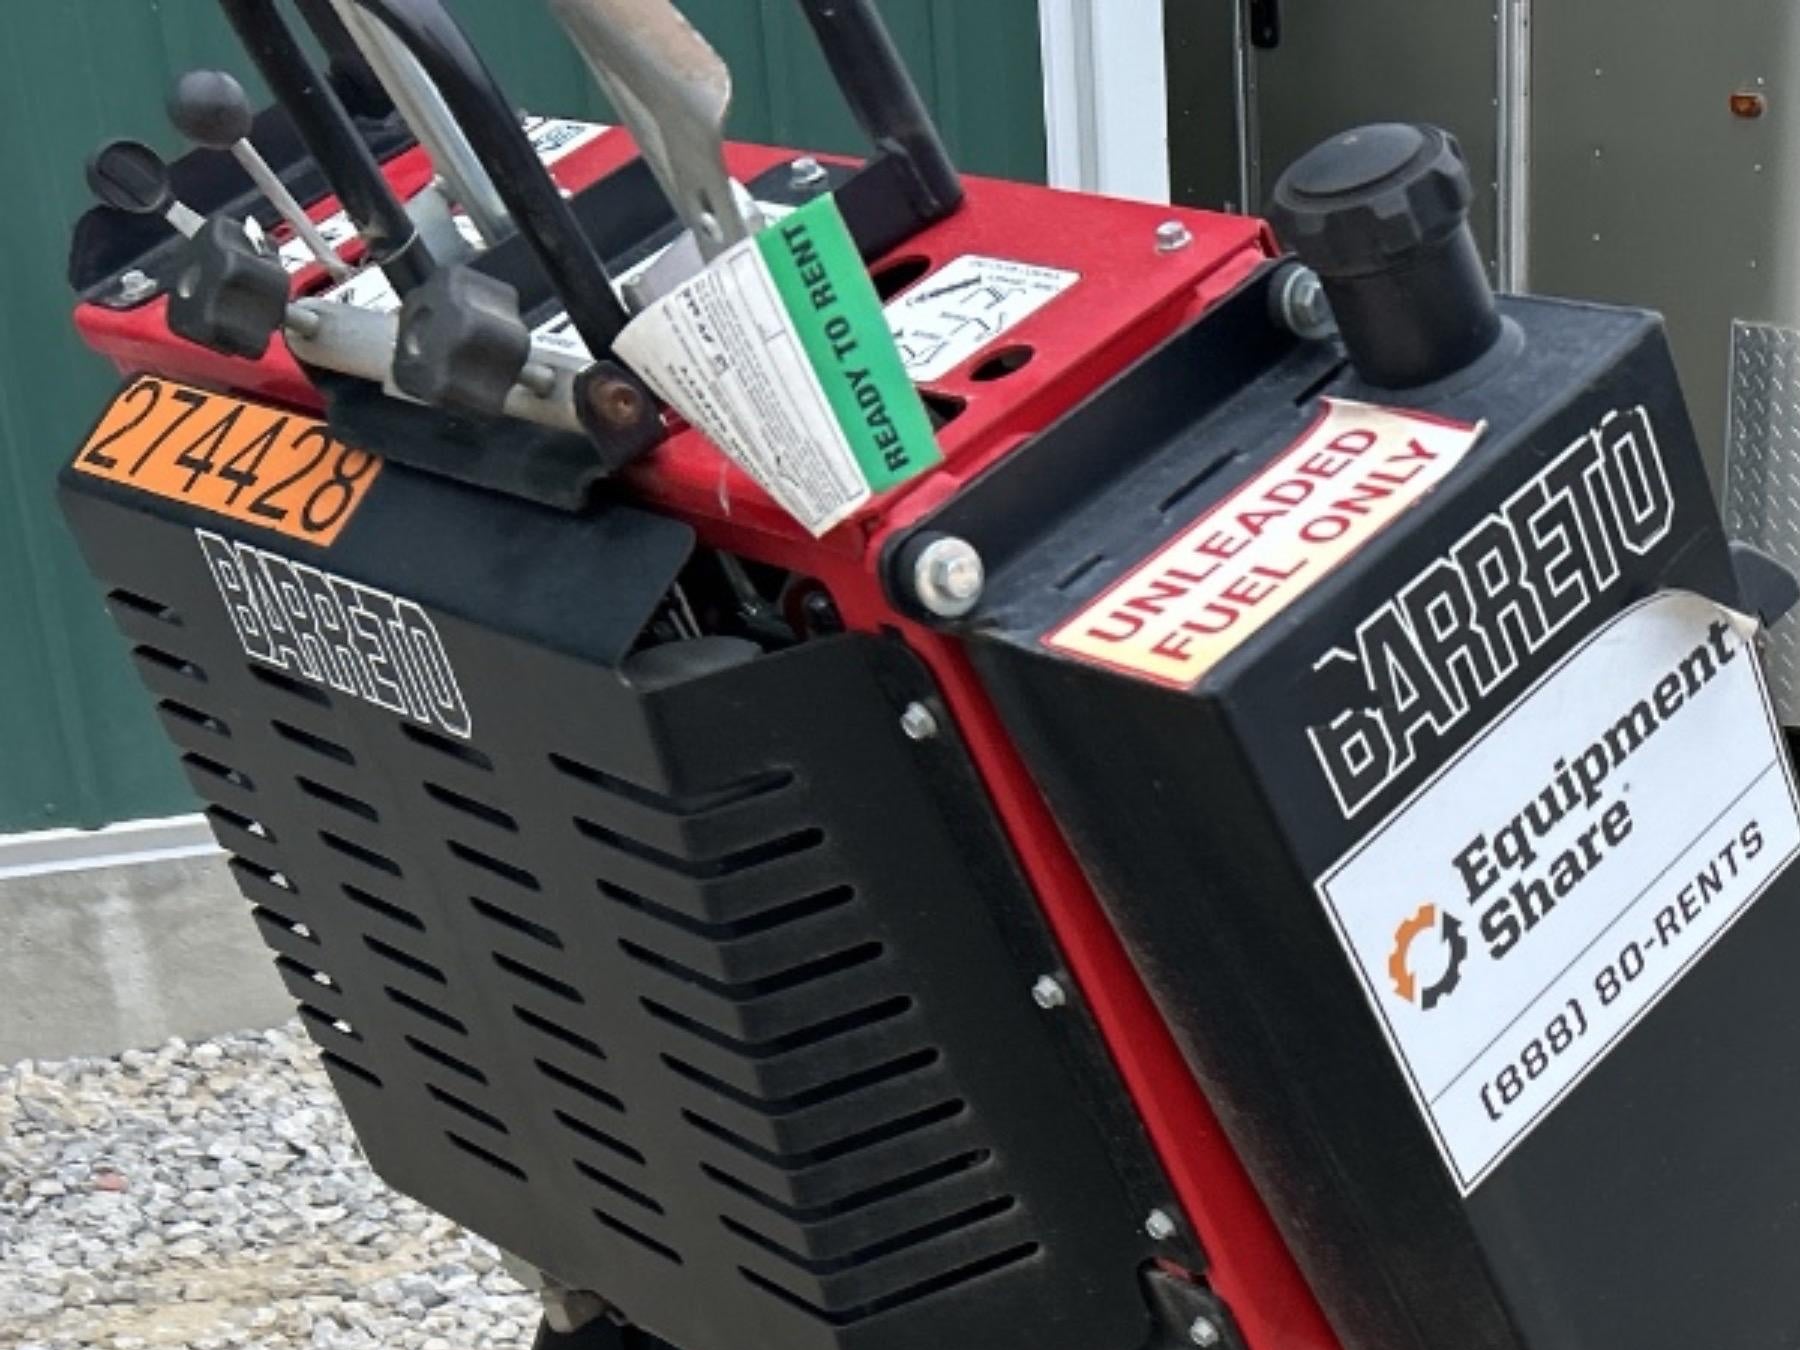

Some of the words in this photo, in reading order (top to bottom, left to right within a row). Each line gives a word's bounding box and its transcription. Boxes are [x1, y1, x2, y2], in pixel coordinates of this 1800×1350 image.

[780, 223, 839, 312] RENT
[823, 316, 861, 362] TO
[82, 379, 382, 533] 274428
[846, 367, 911, 473] READY
[194, 526, 472, 740] BARRETO
[1087, 427, 1379, 644] UNLEADED
[1150, 558, 1310, 663] FUEL
[1300, 437, 1440, 544] ONLY
[1306, 404, 1676, 820] BARRETO
[1451, 618, 1737, 905] Equipment
[1478, 798, 1634, 962] Share
[1478, 998, 1591, 1122] (888)
[1593, 821, 1766, 1007] 80-RENTS
